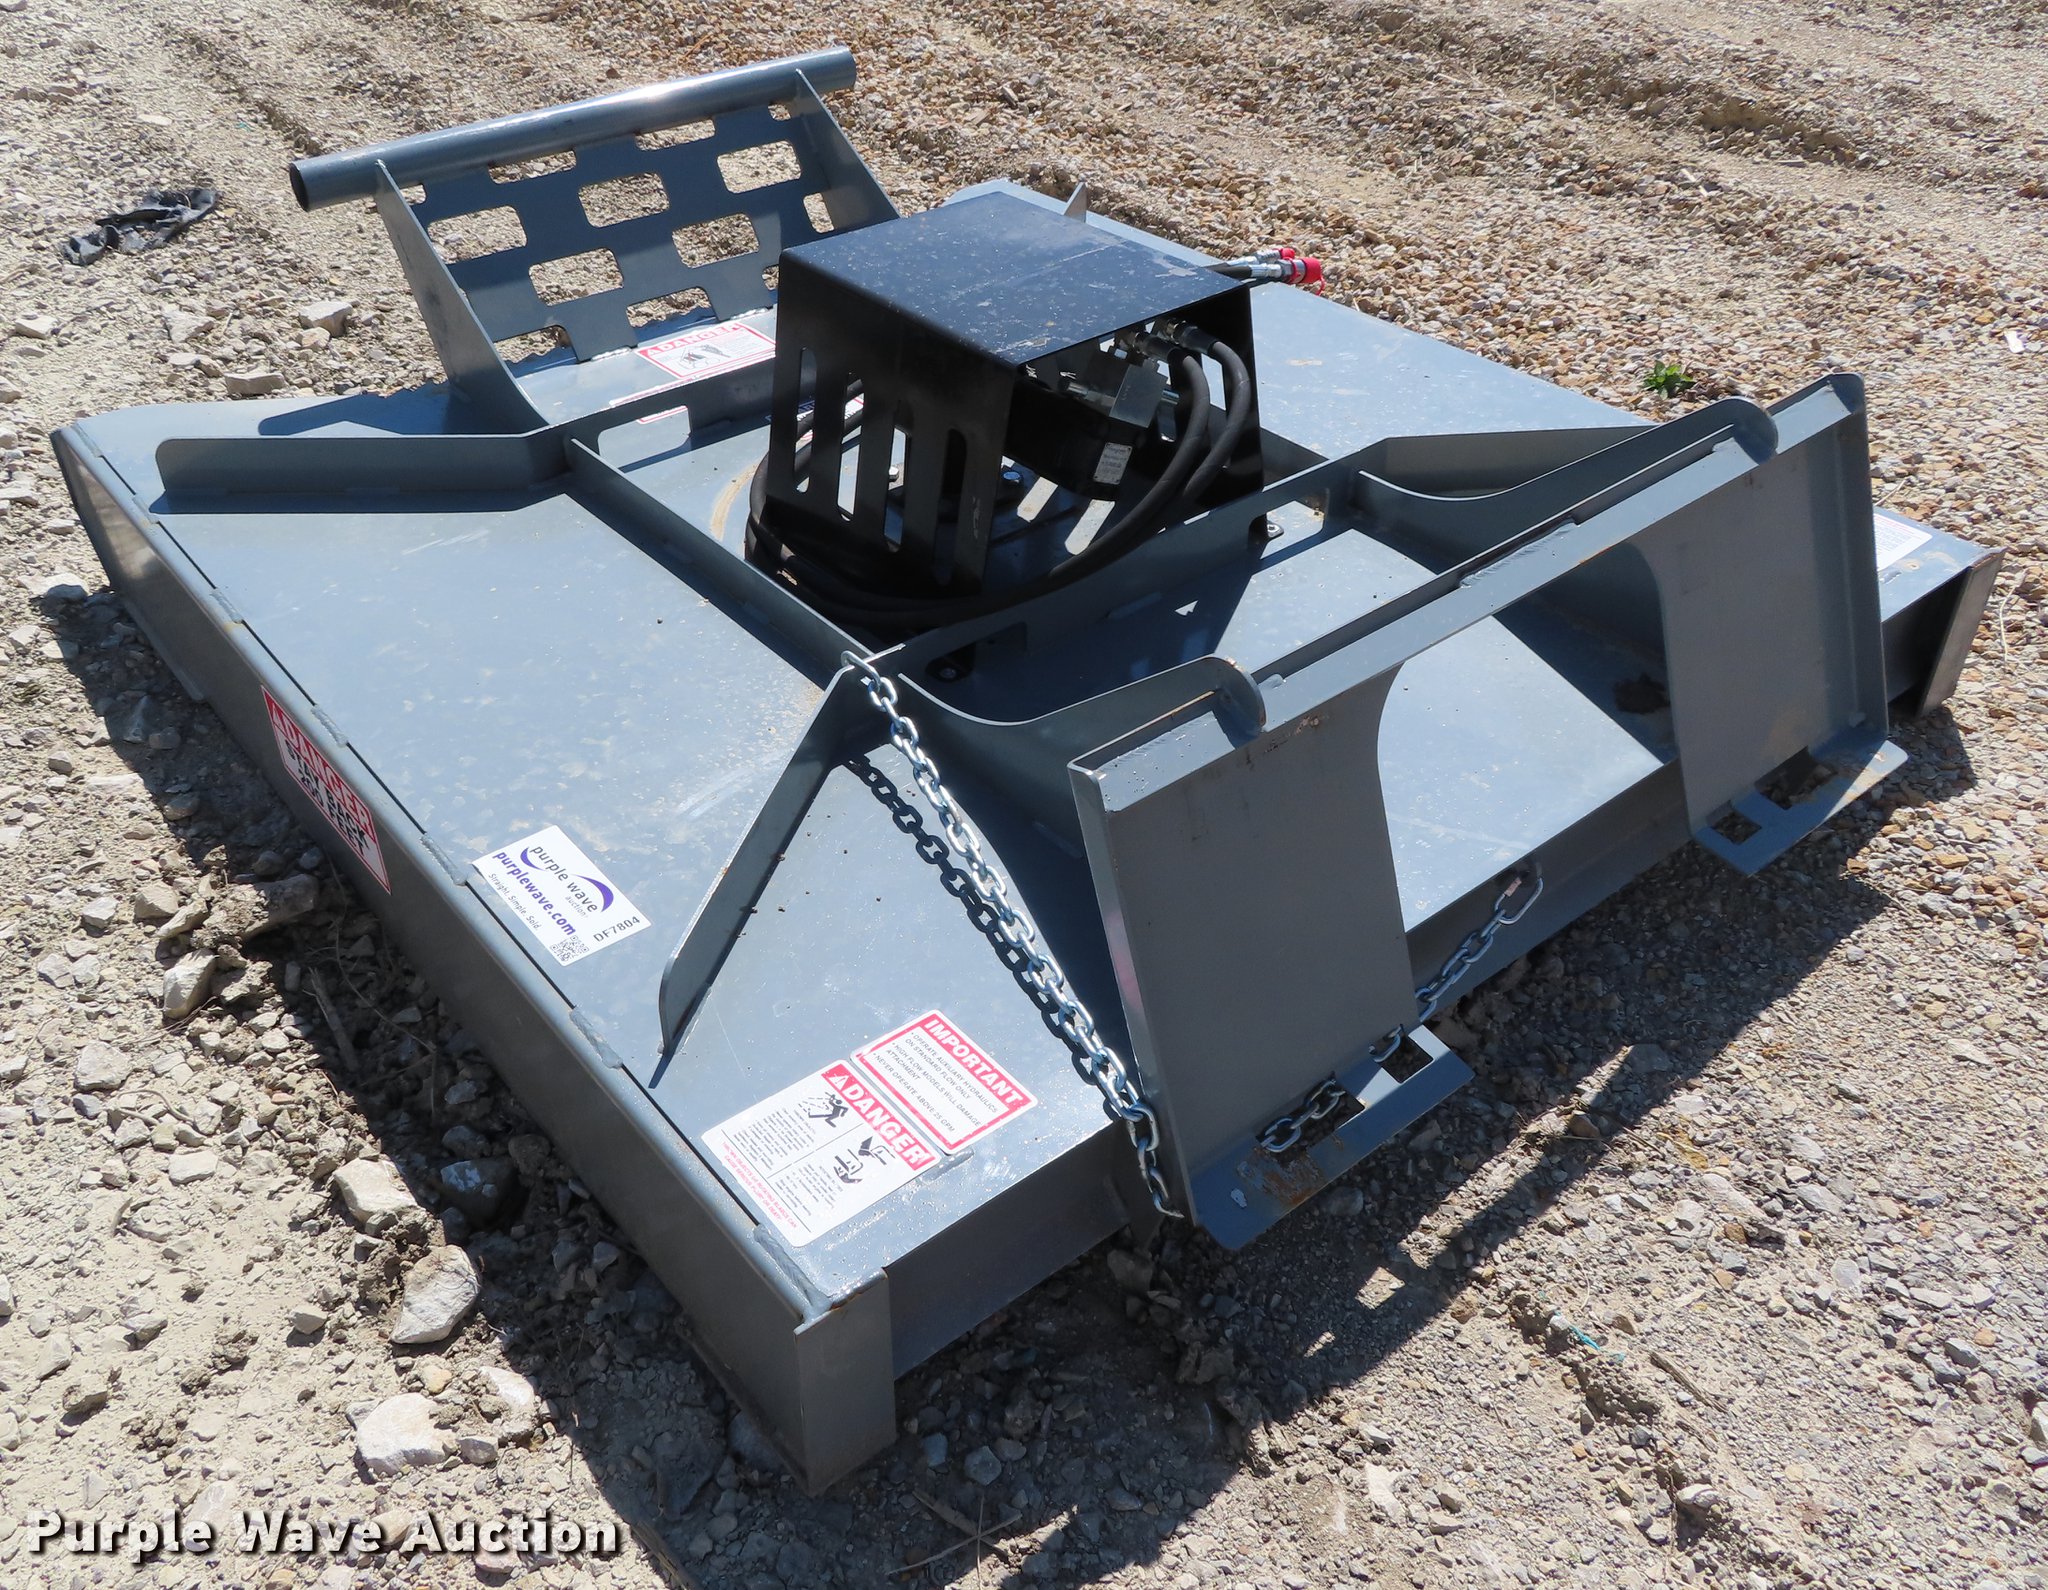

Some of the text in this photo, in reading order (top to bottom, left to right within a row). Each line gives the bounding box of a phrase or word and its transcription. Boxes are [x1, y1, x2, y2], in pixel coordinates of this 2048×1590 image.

[658, 325, 741, 351] DANGER
[281, 712, 374, 840] DANGER
[284, 739, 369, 849] STAY BACK
[327, 802, 364, 856] FEET
[493, 851, 576, 935] purplewave.com
[530, 846, 598, 912] purple wave
[565, 896, 586, 917] auction
[593, 916, 640, 942] DF7804
[873, 1055, 894, 1073] NEVER
[890, 1071, 918, 1095] OPERATE
[914, 1094, 936, 1113] ABOVE
[939, 1118, 956, 1132] GPM
[885, 1048, 920, 1080] ATTACHMENT
[892, 1044, 982, 1126] HIGH FLOW MODELS WILL DAMAGE
[904, 1038, 971, 1099] ON STANDARD FLOW ONLY
[912, 1034, 998, 1113] OPERATE AUXILIARY HYDRAULICS
[924, 1019, 1022, 1106] IMPORTANT
[846, 1081, 930, 1168] DANGER
